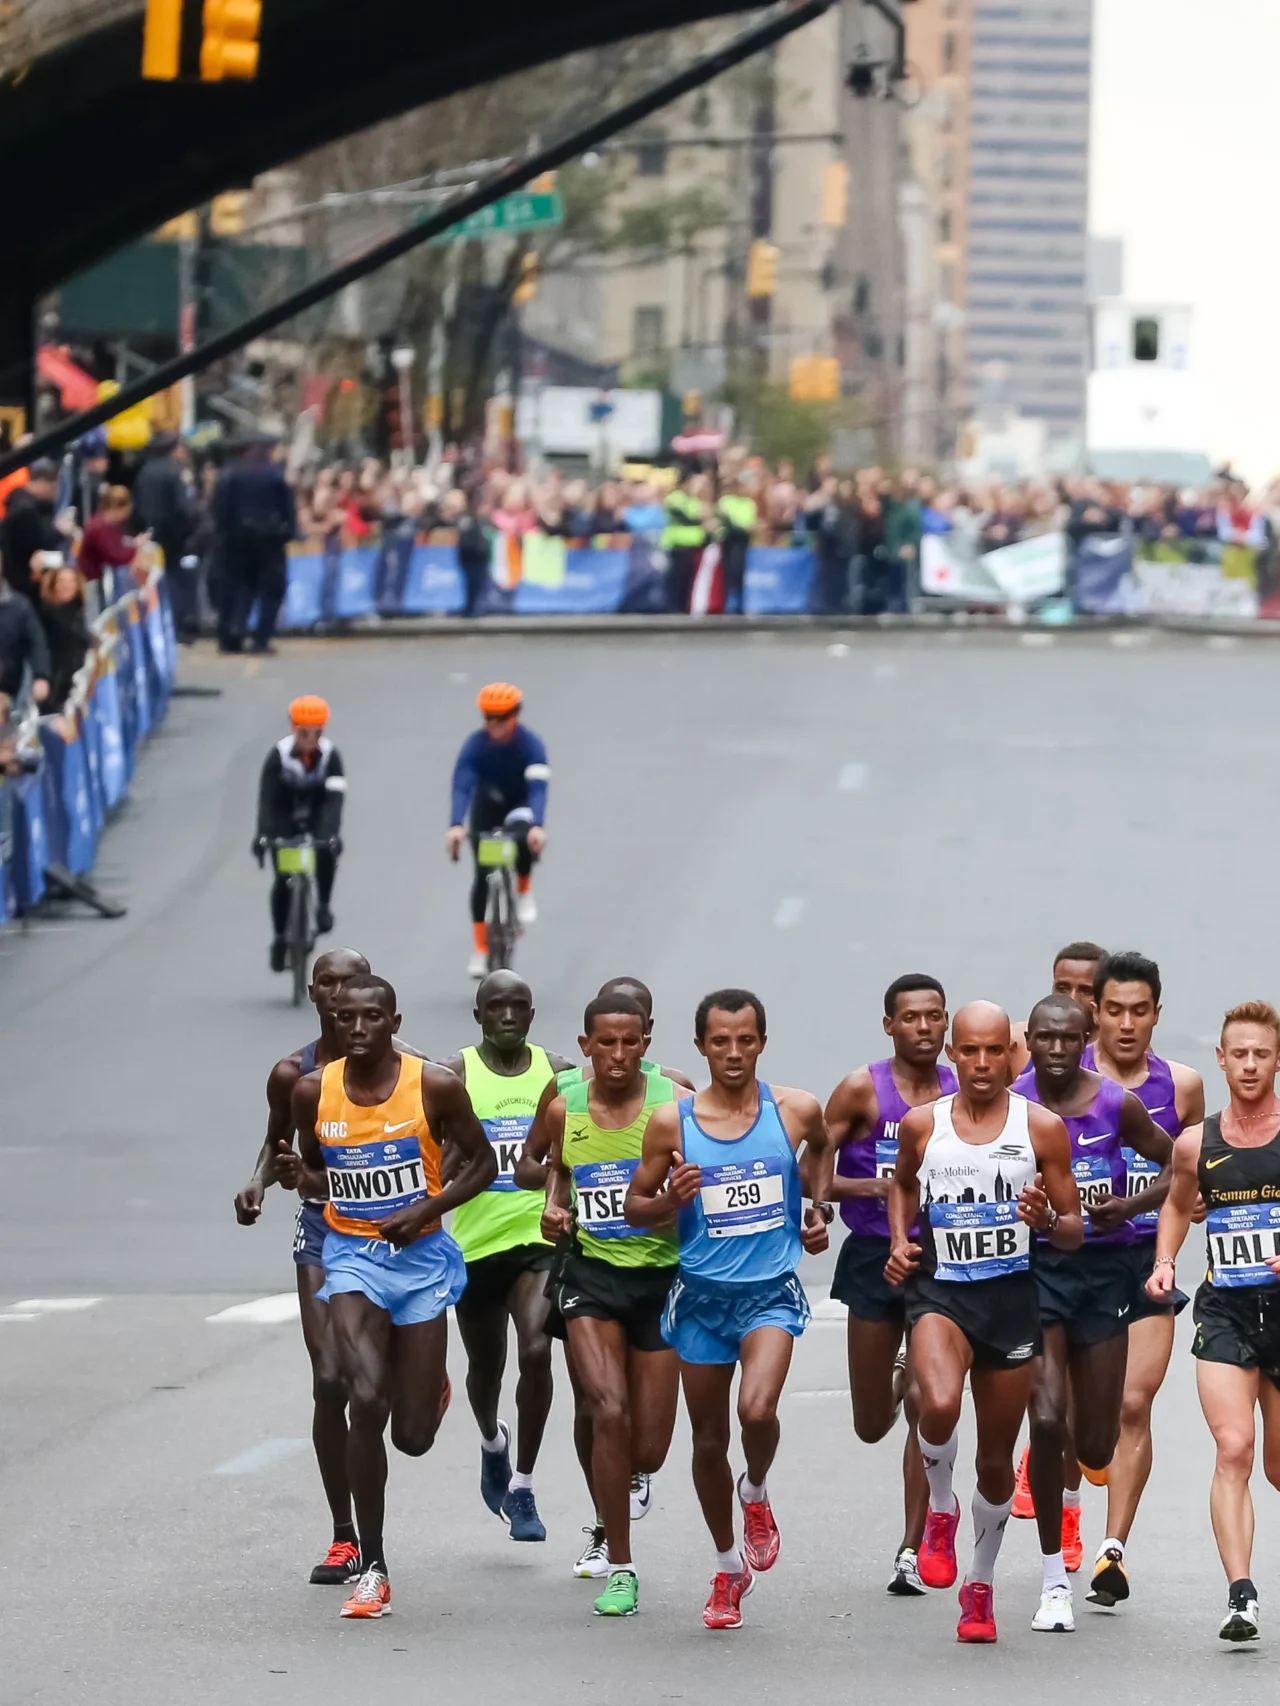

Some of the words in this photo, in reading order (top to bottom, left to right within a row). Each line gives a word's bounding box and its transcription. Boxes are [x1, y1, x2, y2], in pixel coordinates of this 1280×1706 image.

[494, 1097, 539, 1111] WESTCHESTER
[320, 1121, 348, 1138] NRC
[337, 1152, 375, 1160] CONSULTANCY
[989, 1153, 1028, 1162] SKECHERS
[345, 1159, 369, 1167] SERVICES
[590, 1169, 630, 1178] CONSULTANCY
[713, 1169, 746, 1178] CONSULTANCY
[329, 1161, 421, 1200] BIWOTT
[598, 1176, 624, 1184] SERVICES
[725, 1183, 761, 1208] 259
[579, 1188, 625, 1220] TSE
[945, 1211, 987, 1219] CONSULTANCY
[1221, 1214, 1260, 1224] CONSULTANCY
[1227, 1221, 1254, 1230] SERVICES
[945, 1227, 1018, 1261] MEB
